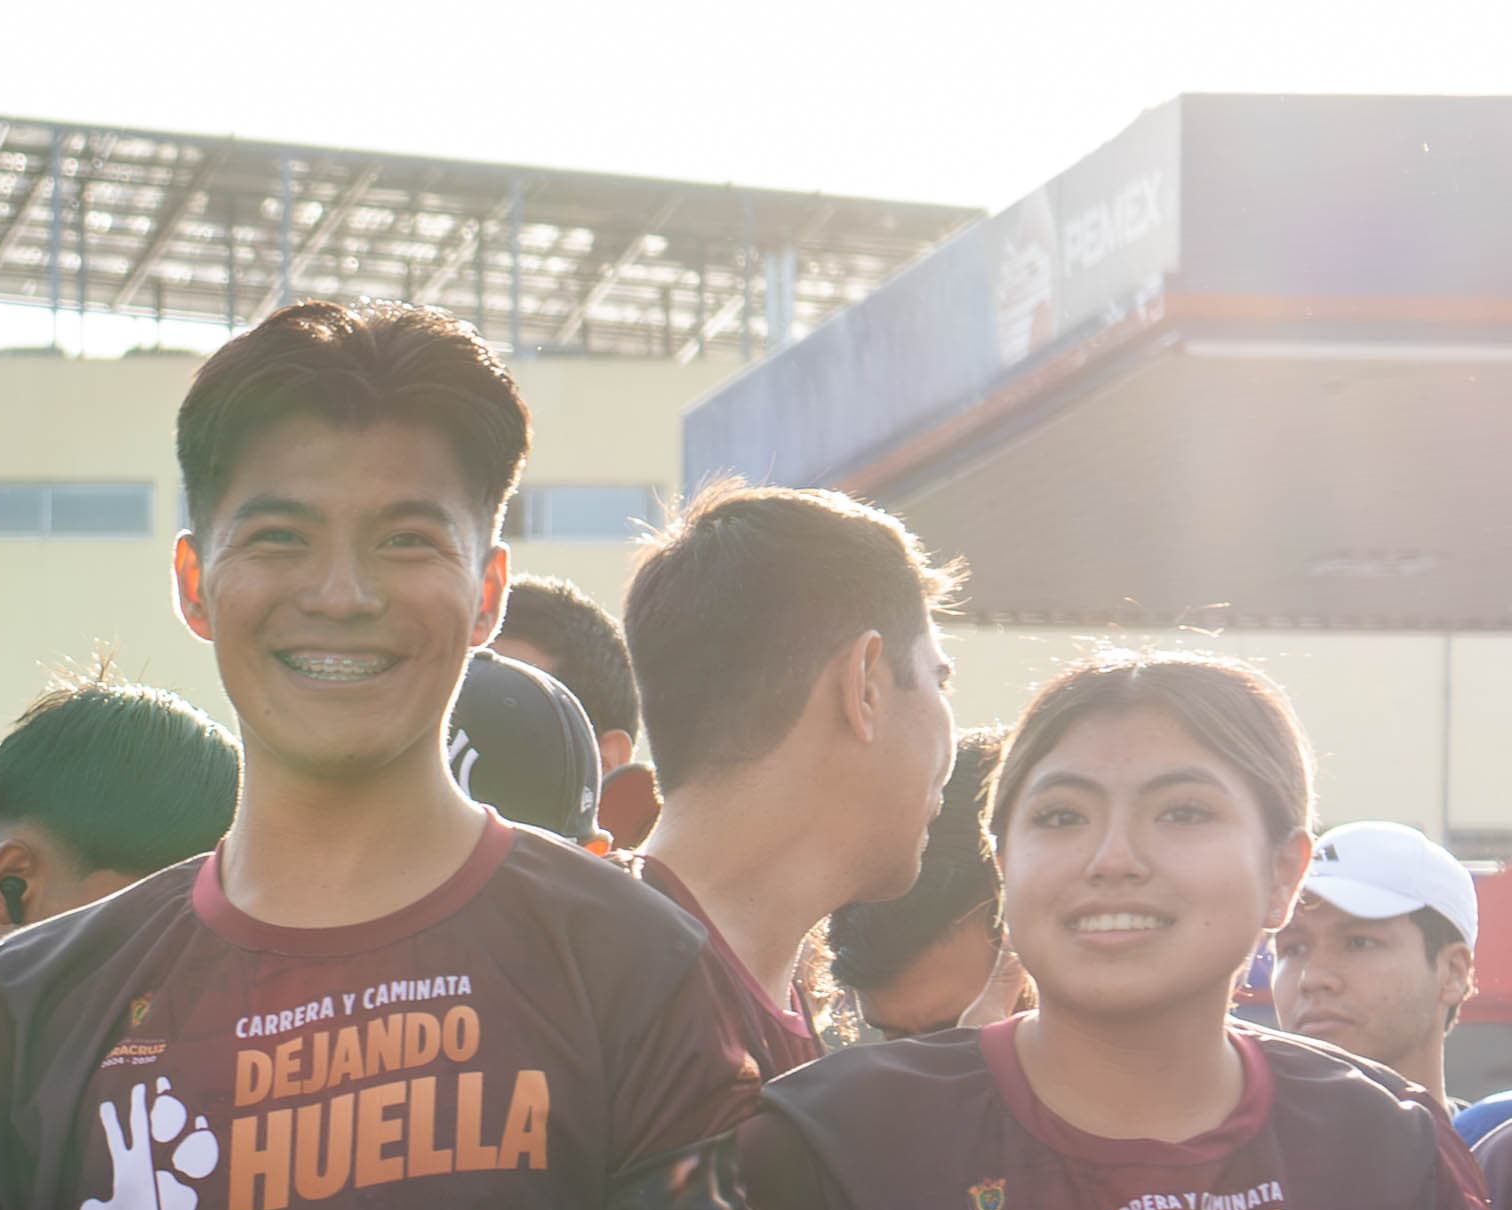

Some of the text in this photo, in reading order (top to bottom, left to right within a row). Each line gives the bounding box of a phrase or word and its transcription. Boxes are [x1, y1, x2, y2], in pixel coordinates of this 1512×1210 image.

[1064, 169, 1162, 279] PEMEX
[235, 974, 472, 1039] CARRERA Y CAMINATA
[234, 1005, 481, 1107] DEJANDO
[1182, 1191, 1198, 1210] Y
